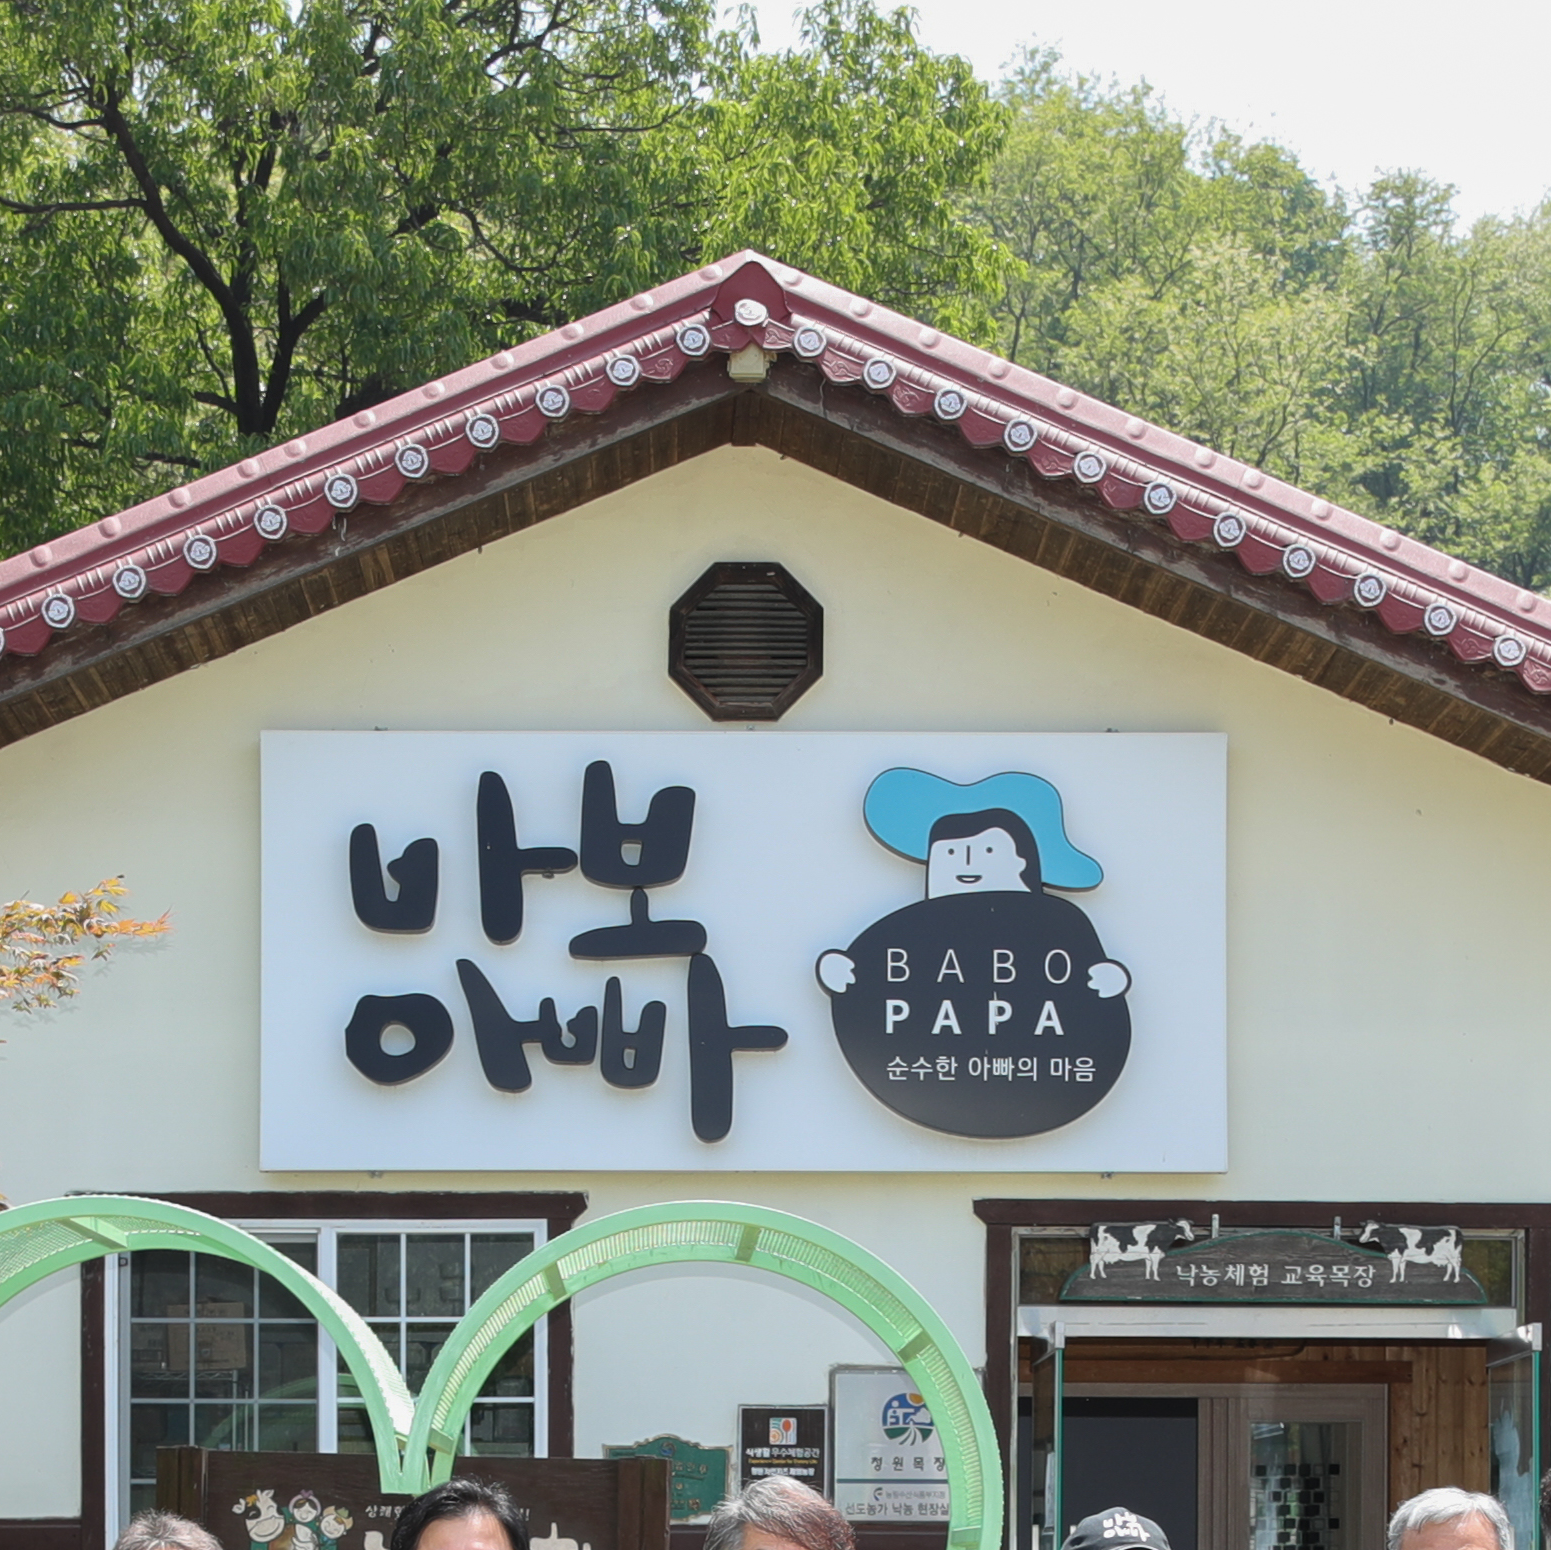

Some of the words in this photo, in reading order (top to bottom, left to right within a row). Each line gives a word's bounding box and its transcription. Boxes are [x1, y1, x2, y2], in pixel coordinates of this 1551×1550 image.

[348, 758, 708, 961] 바보
[886, 947, 1073, 985] BABO
[884, 998, 1065, 1036] PAPA
[344, 950, 790, 1144] 아빠
[886, 1055, 959, 1081] 순수한
[968, 1056, 1038, 1082] 아빠의
[1050, 1056, 1096, 1083] 마음
[1175, 1263, 1270, 1287] 낙농체험
[1280, 1263, 1376, 1288] 교육목장
[892, 1502, 913, 1516] 낙농
[917, 1502, 949, 1516] 현장실
